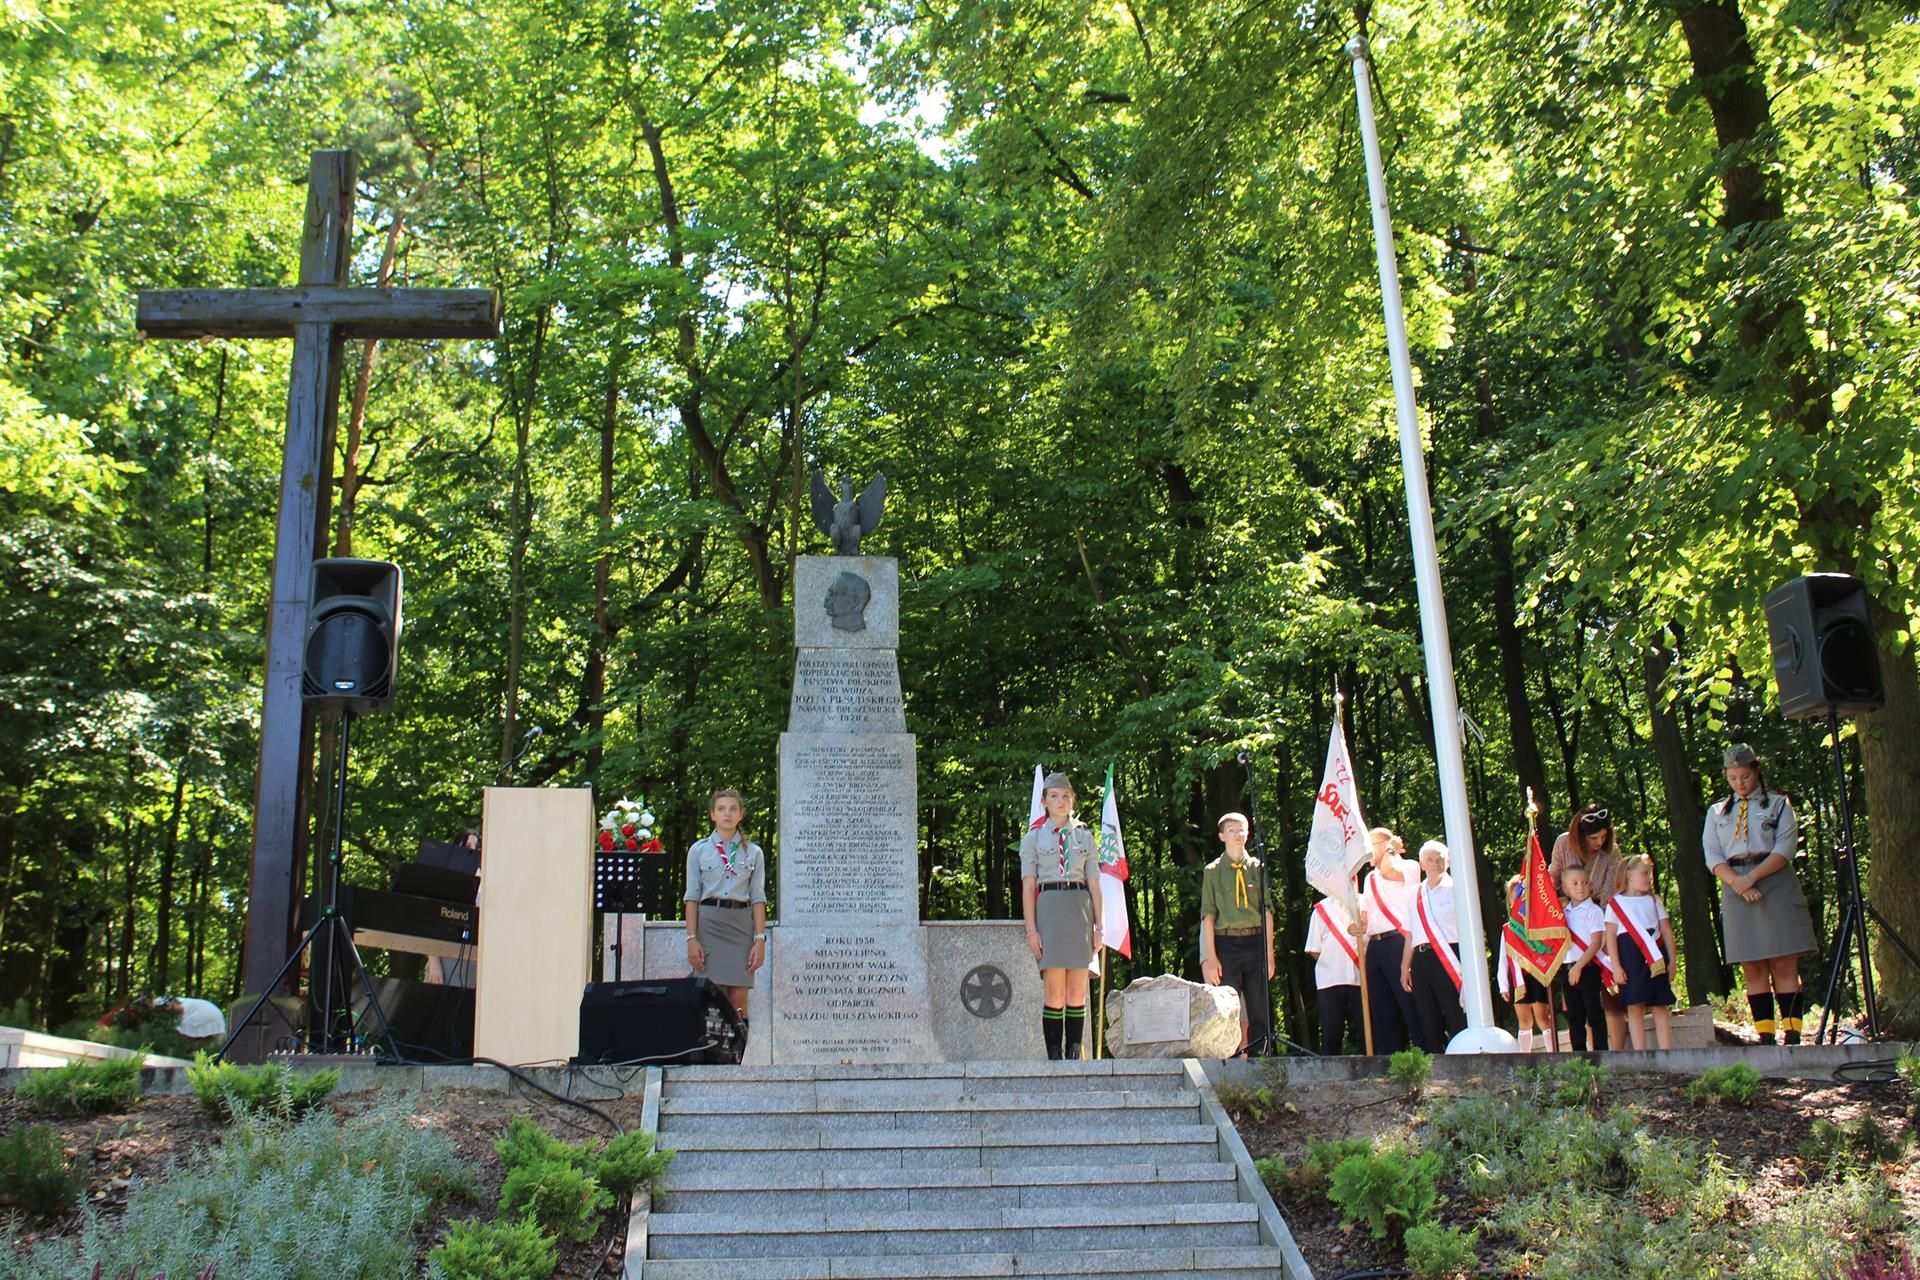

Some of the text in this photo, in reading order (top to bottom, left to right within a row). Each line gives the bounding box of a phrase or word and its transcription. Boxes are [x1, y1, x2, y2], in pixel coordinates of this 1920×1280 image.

[440, 906, 469, 921] Roland
[826, 937, 853, 945] ROKU
[805, 962, 896, 970] BOHATEROM WALK
[858, 974, 909, 982] OJCZYZNY
[795, 987, 804, 995] W
[827, 1000, 875, 1008] ODPARCIA
